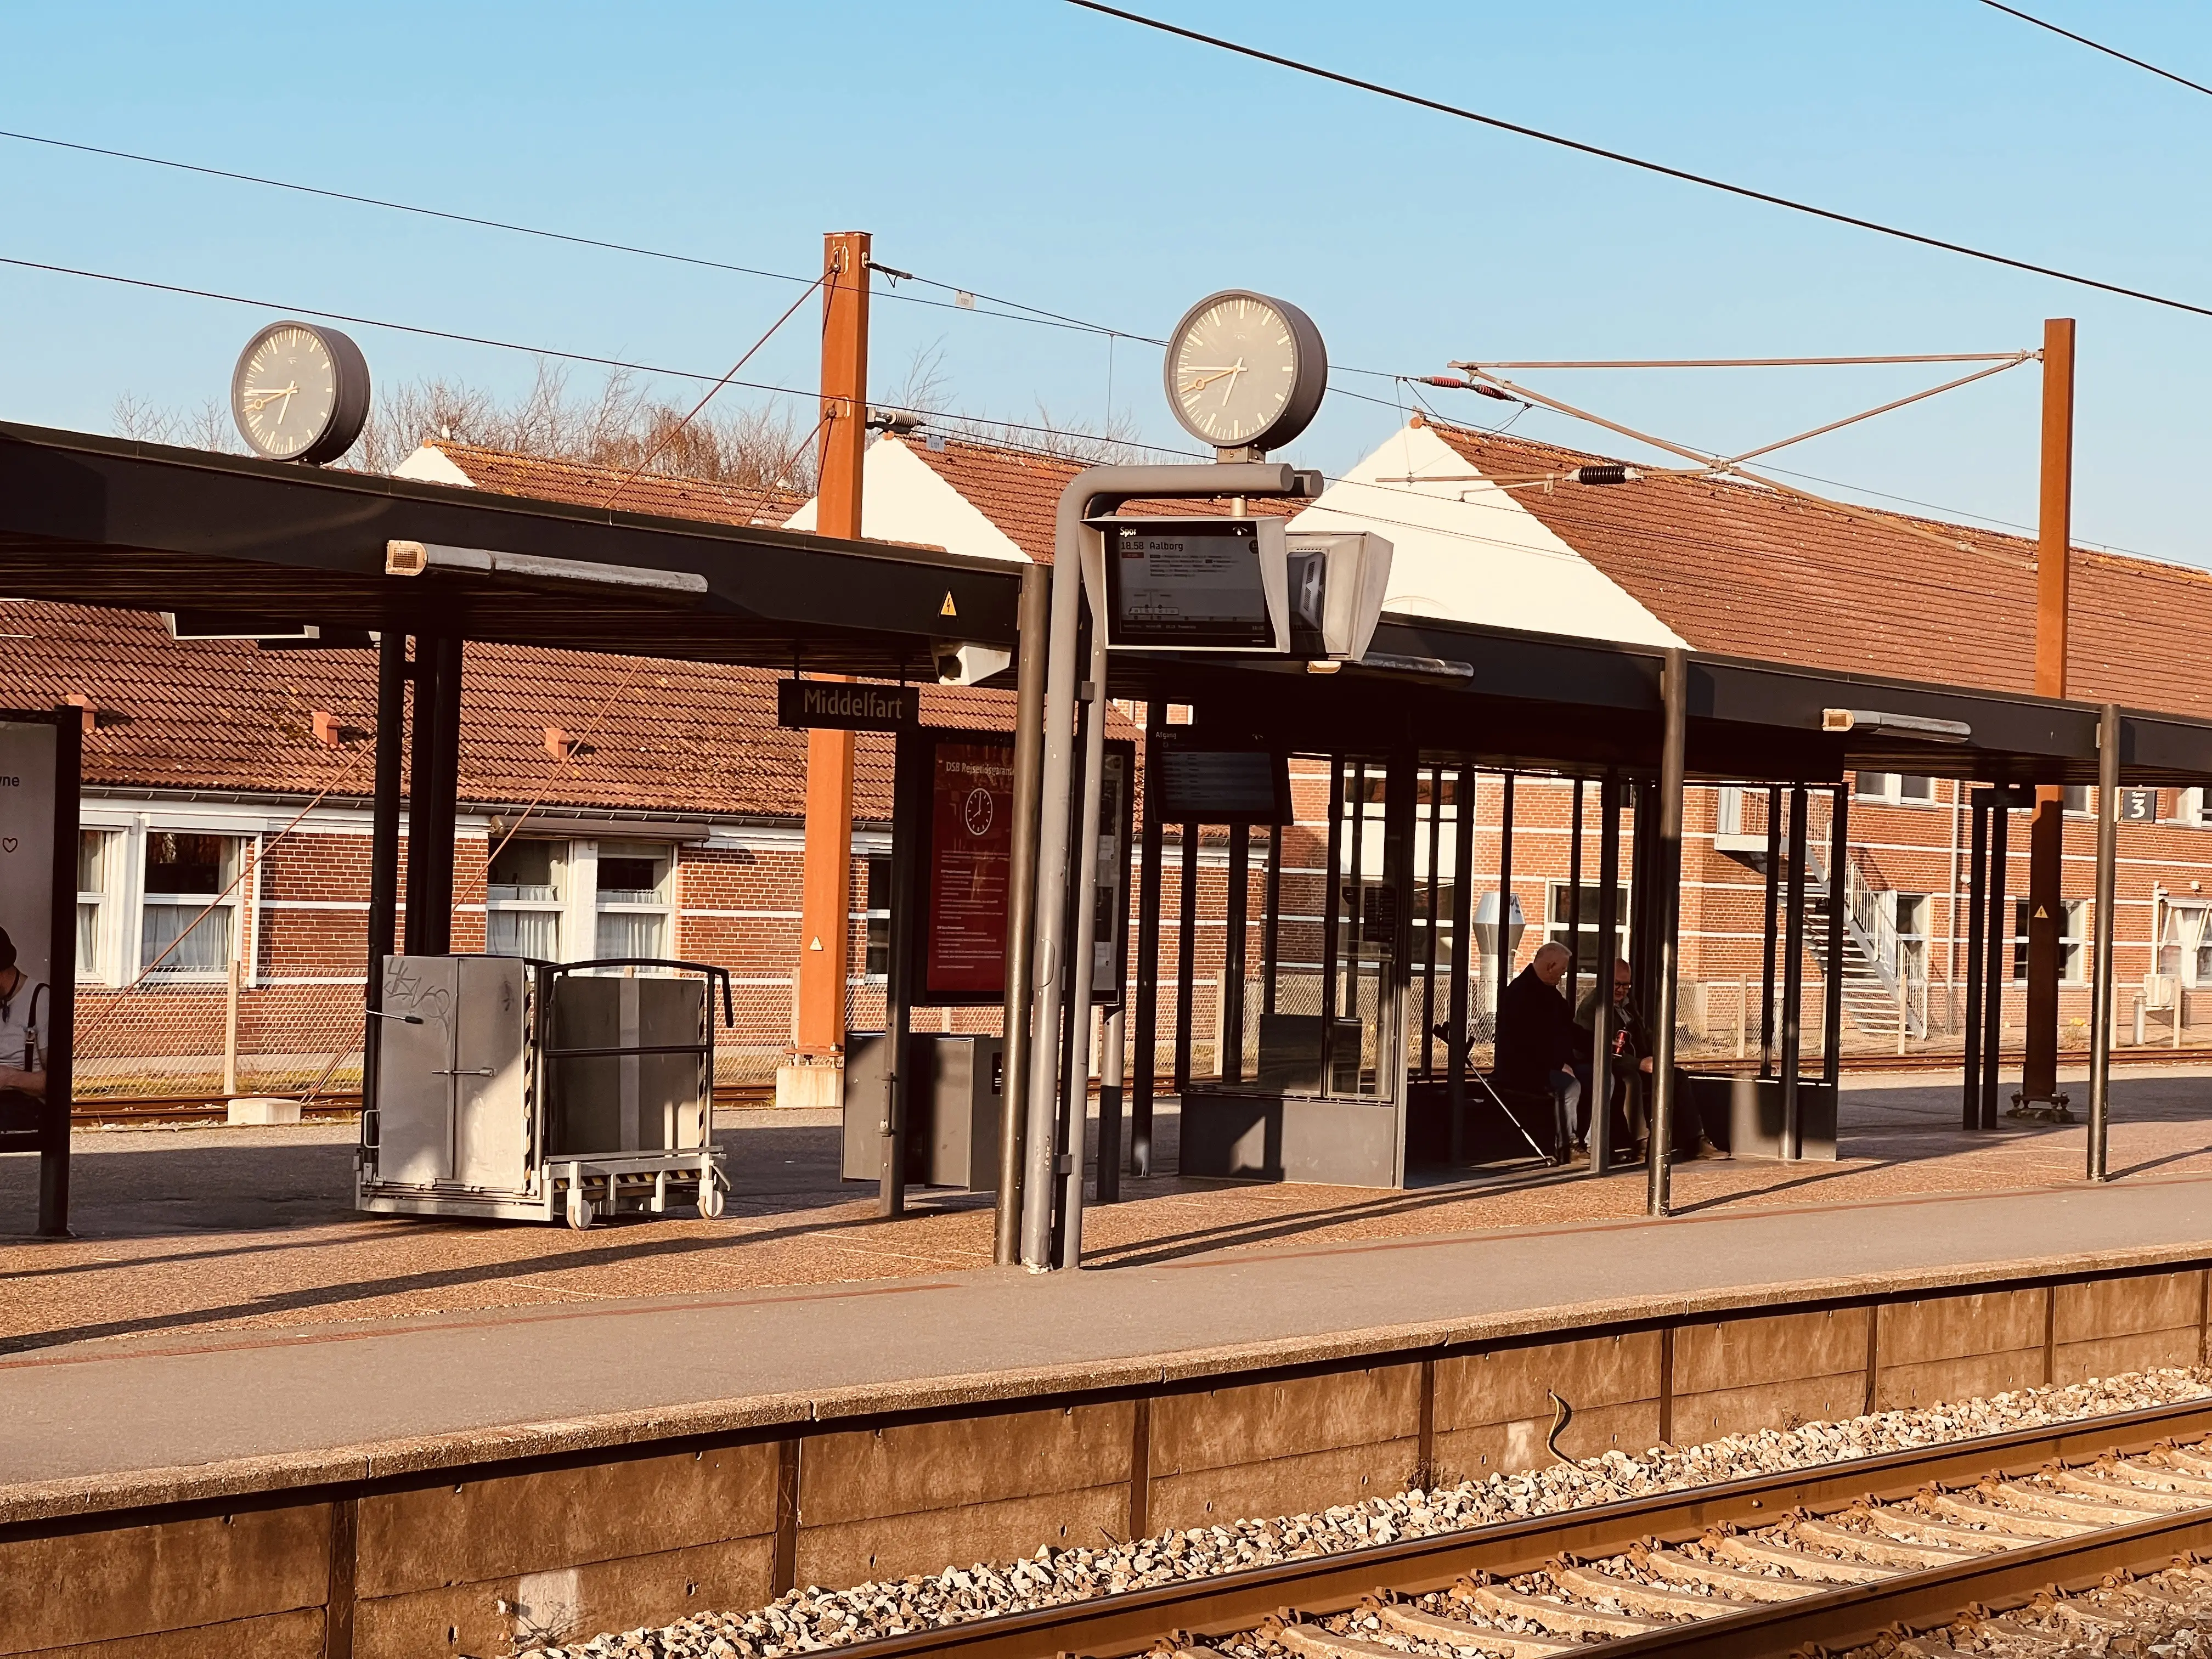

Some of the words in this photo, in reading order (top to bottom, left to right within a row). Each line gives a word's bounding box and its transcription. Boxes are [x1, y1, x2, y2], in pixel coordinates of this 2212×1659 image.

[1120, 527, 1136, 538] Spor
[1121, 541, 1144, 550] 18.58
[1149, 541, 1183, 551] Aalborg
[804, 689, 902, 719] Middelfart
[1156, 731, 1177, 740] Afgang
[946, 761, 960, 772] DSB
[2130, 799, 2146, 819] 3
